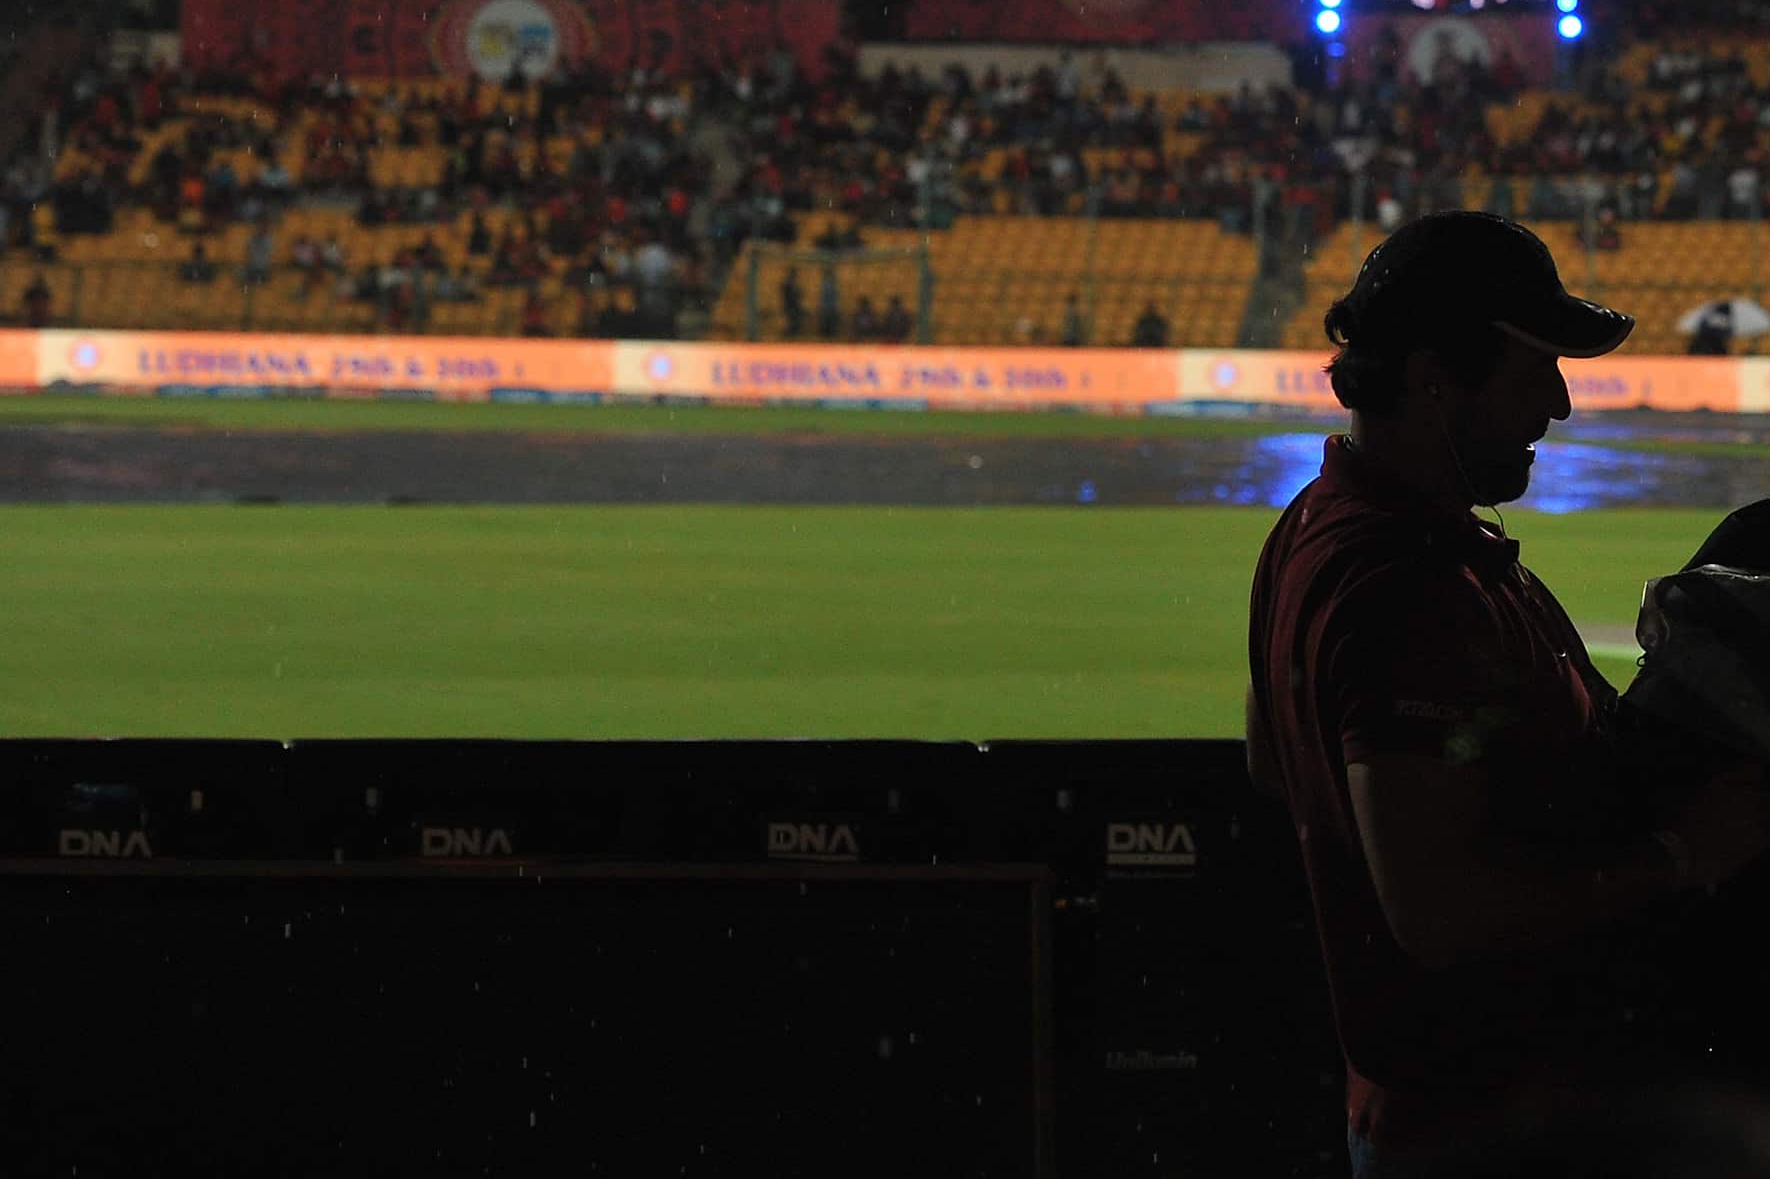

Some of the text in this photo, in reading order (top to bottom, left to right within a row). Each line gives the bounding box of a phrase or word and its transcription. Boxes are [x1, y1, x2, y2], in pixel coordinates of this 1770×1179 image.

[58, 827, 153, 858] DNA
[422, 826, 513, 856] DNA
[767, 822, 857, 853] DNA
[1106, 821, 1197, 853] DNA
